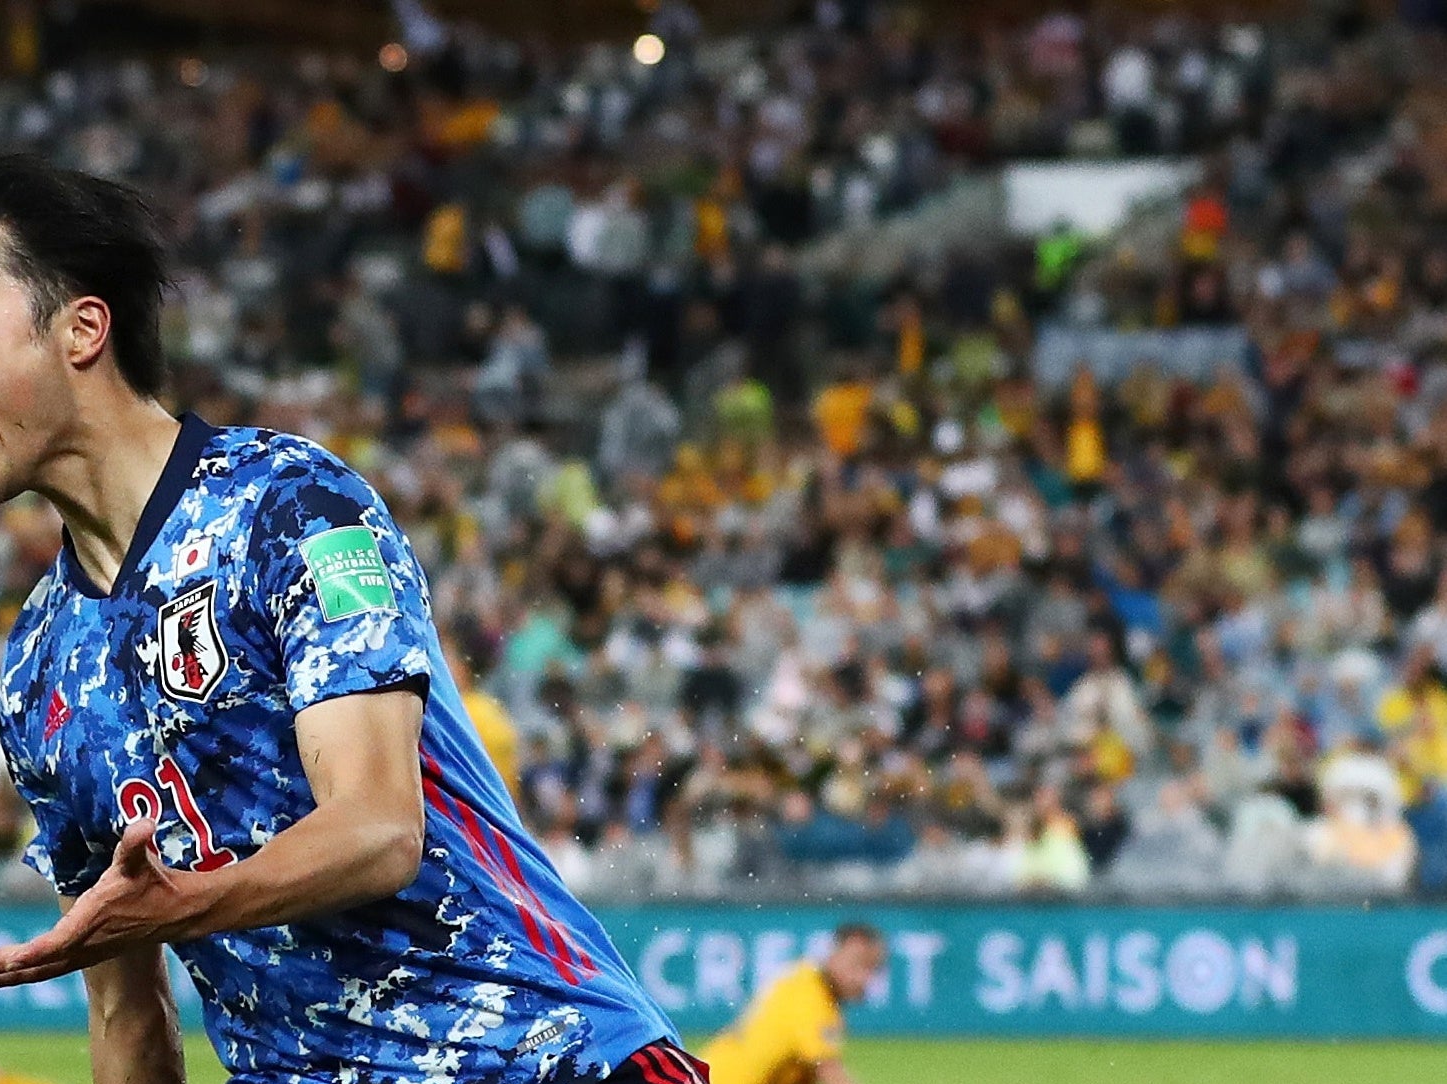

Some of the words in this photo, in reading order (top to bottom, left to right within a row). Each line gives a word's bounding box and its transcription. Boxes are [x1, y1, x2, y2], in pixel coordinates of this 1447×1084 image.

[317, 558, 380, 579] FOOTBALL
[358, 575, 386, 588] FIFA
[172, 591, 203, 613] JAPAN
[116, 757, 239, 874] 21
[976, 928, 1299, 1014] SAISON
